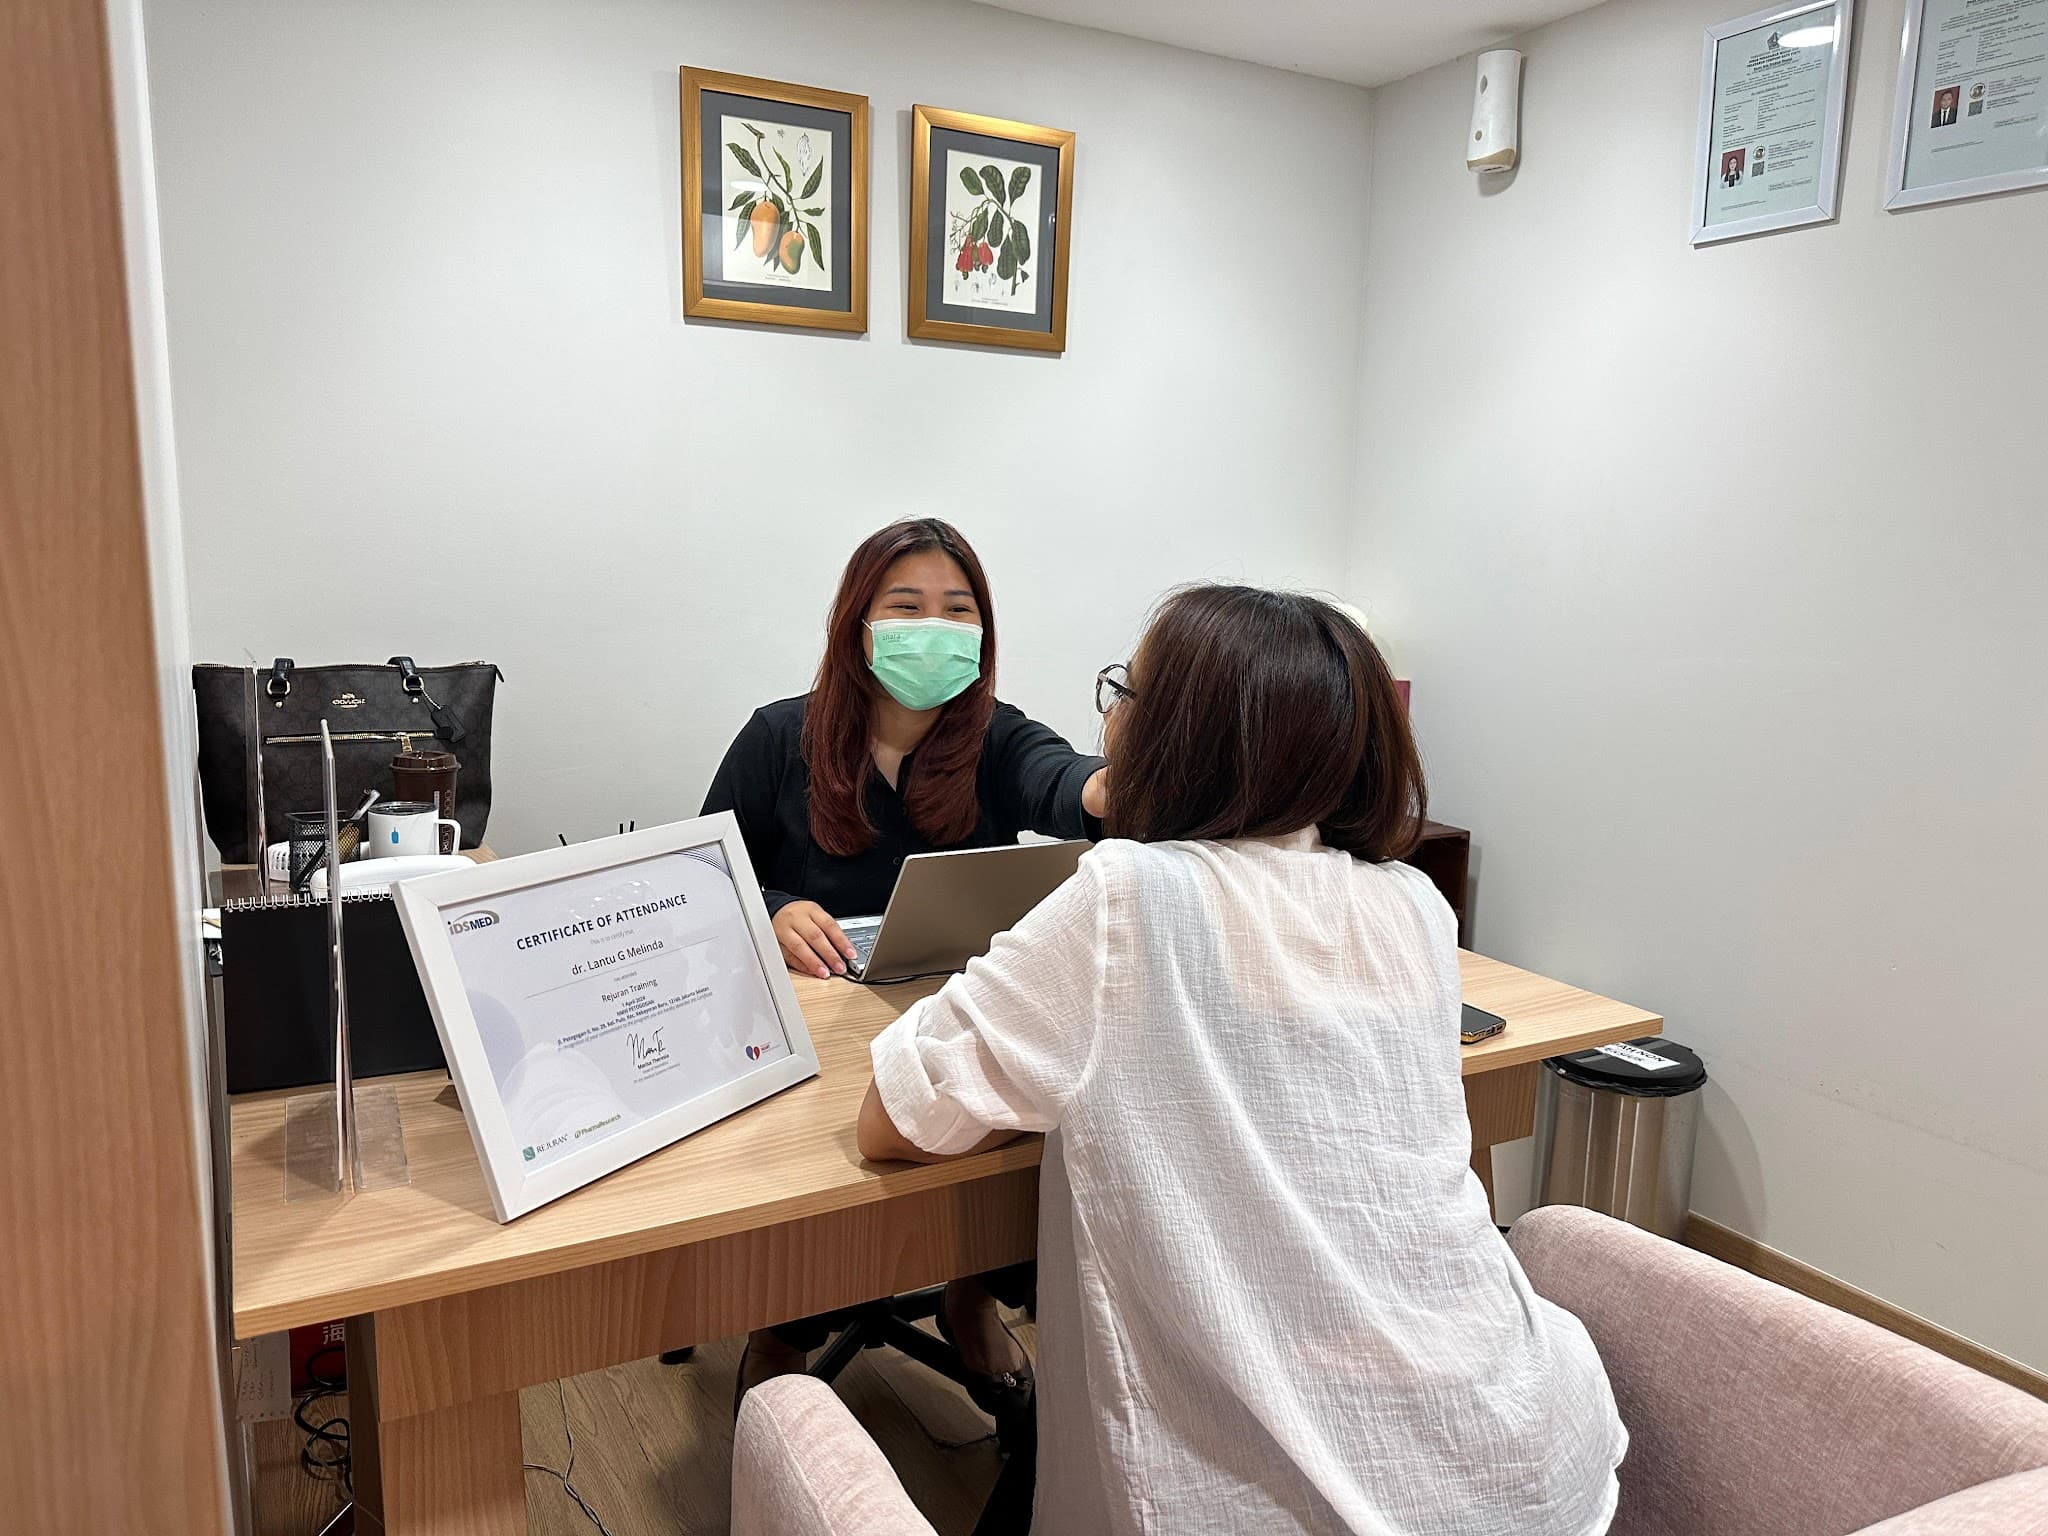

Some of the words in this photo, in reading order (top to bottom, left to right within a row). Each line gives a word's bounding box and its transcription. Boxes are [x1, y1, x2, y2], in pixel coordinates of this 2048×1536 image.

[516, 919, 594, 950] CERTIFICATE
[596, 913, 612, 928] OF
[615, 893, 687, 923] ATTENDANCE
[571, 963, 586, 975] dr.
[586, 954, 616, 970] Lantu
[616, 950, 626, 961] G
[625, 939, 664, 958] Melinda
[600, 988, 629, 1002] Rejuran
[628, 978, 658, 993] Training
[624, 998, 636, 1006] April
